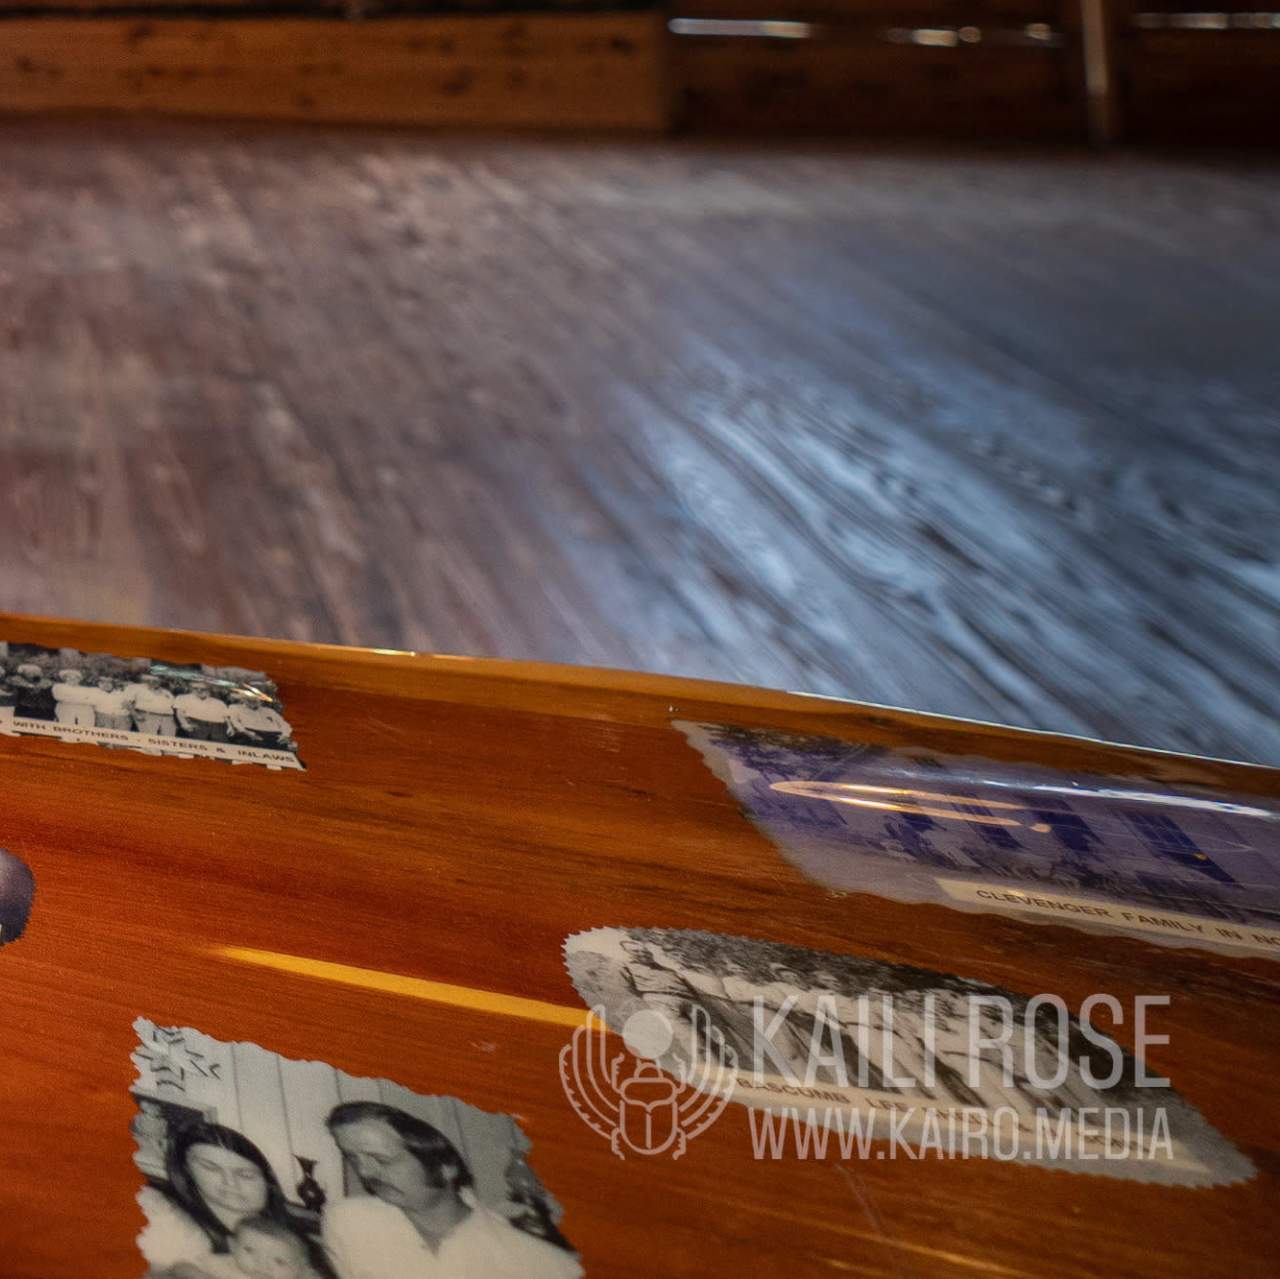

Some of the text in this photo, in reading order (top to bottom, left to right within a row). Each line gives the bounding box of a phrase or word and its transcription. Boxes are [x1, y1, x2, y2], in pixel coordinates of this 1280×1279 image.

[12, 720, 47, 730] WITH
[52, 725, 129, 741] BROTHERS
[148, 738, 208, 751] SISTERS
[976, 888, 1114, 919] CLEVENGER
[1120, 912, 1204, 933] FAMILY
[1214, 927, 1244, 941] IN
